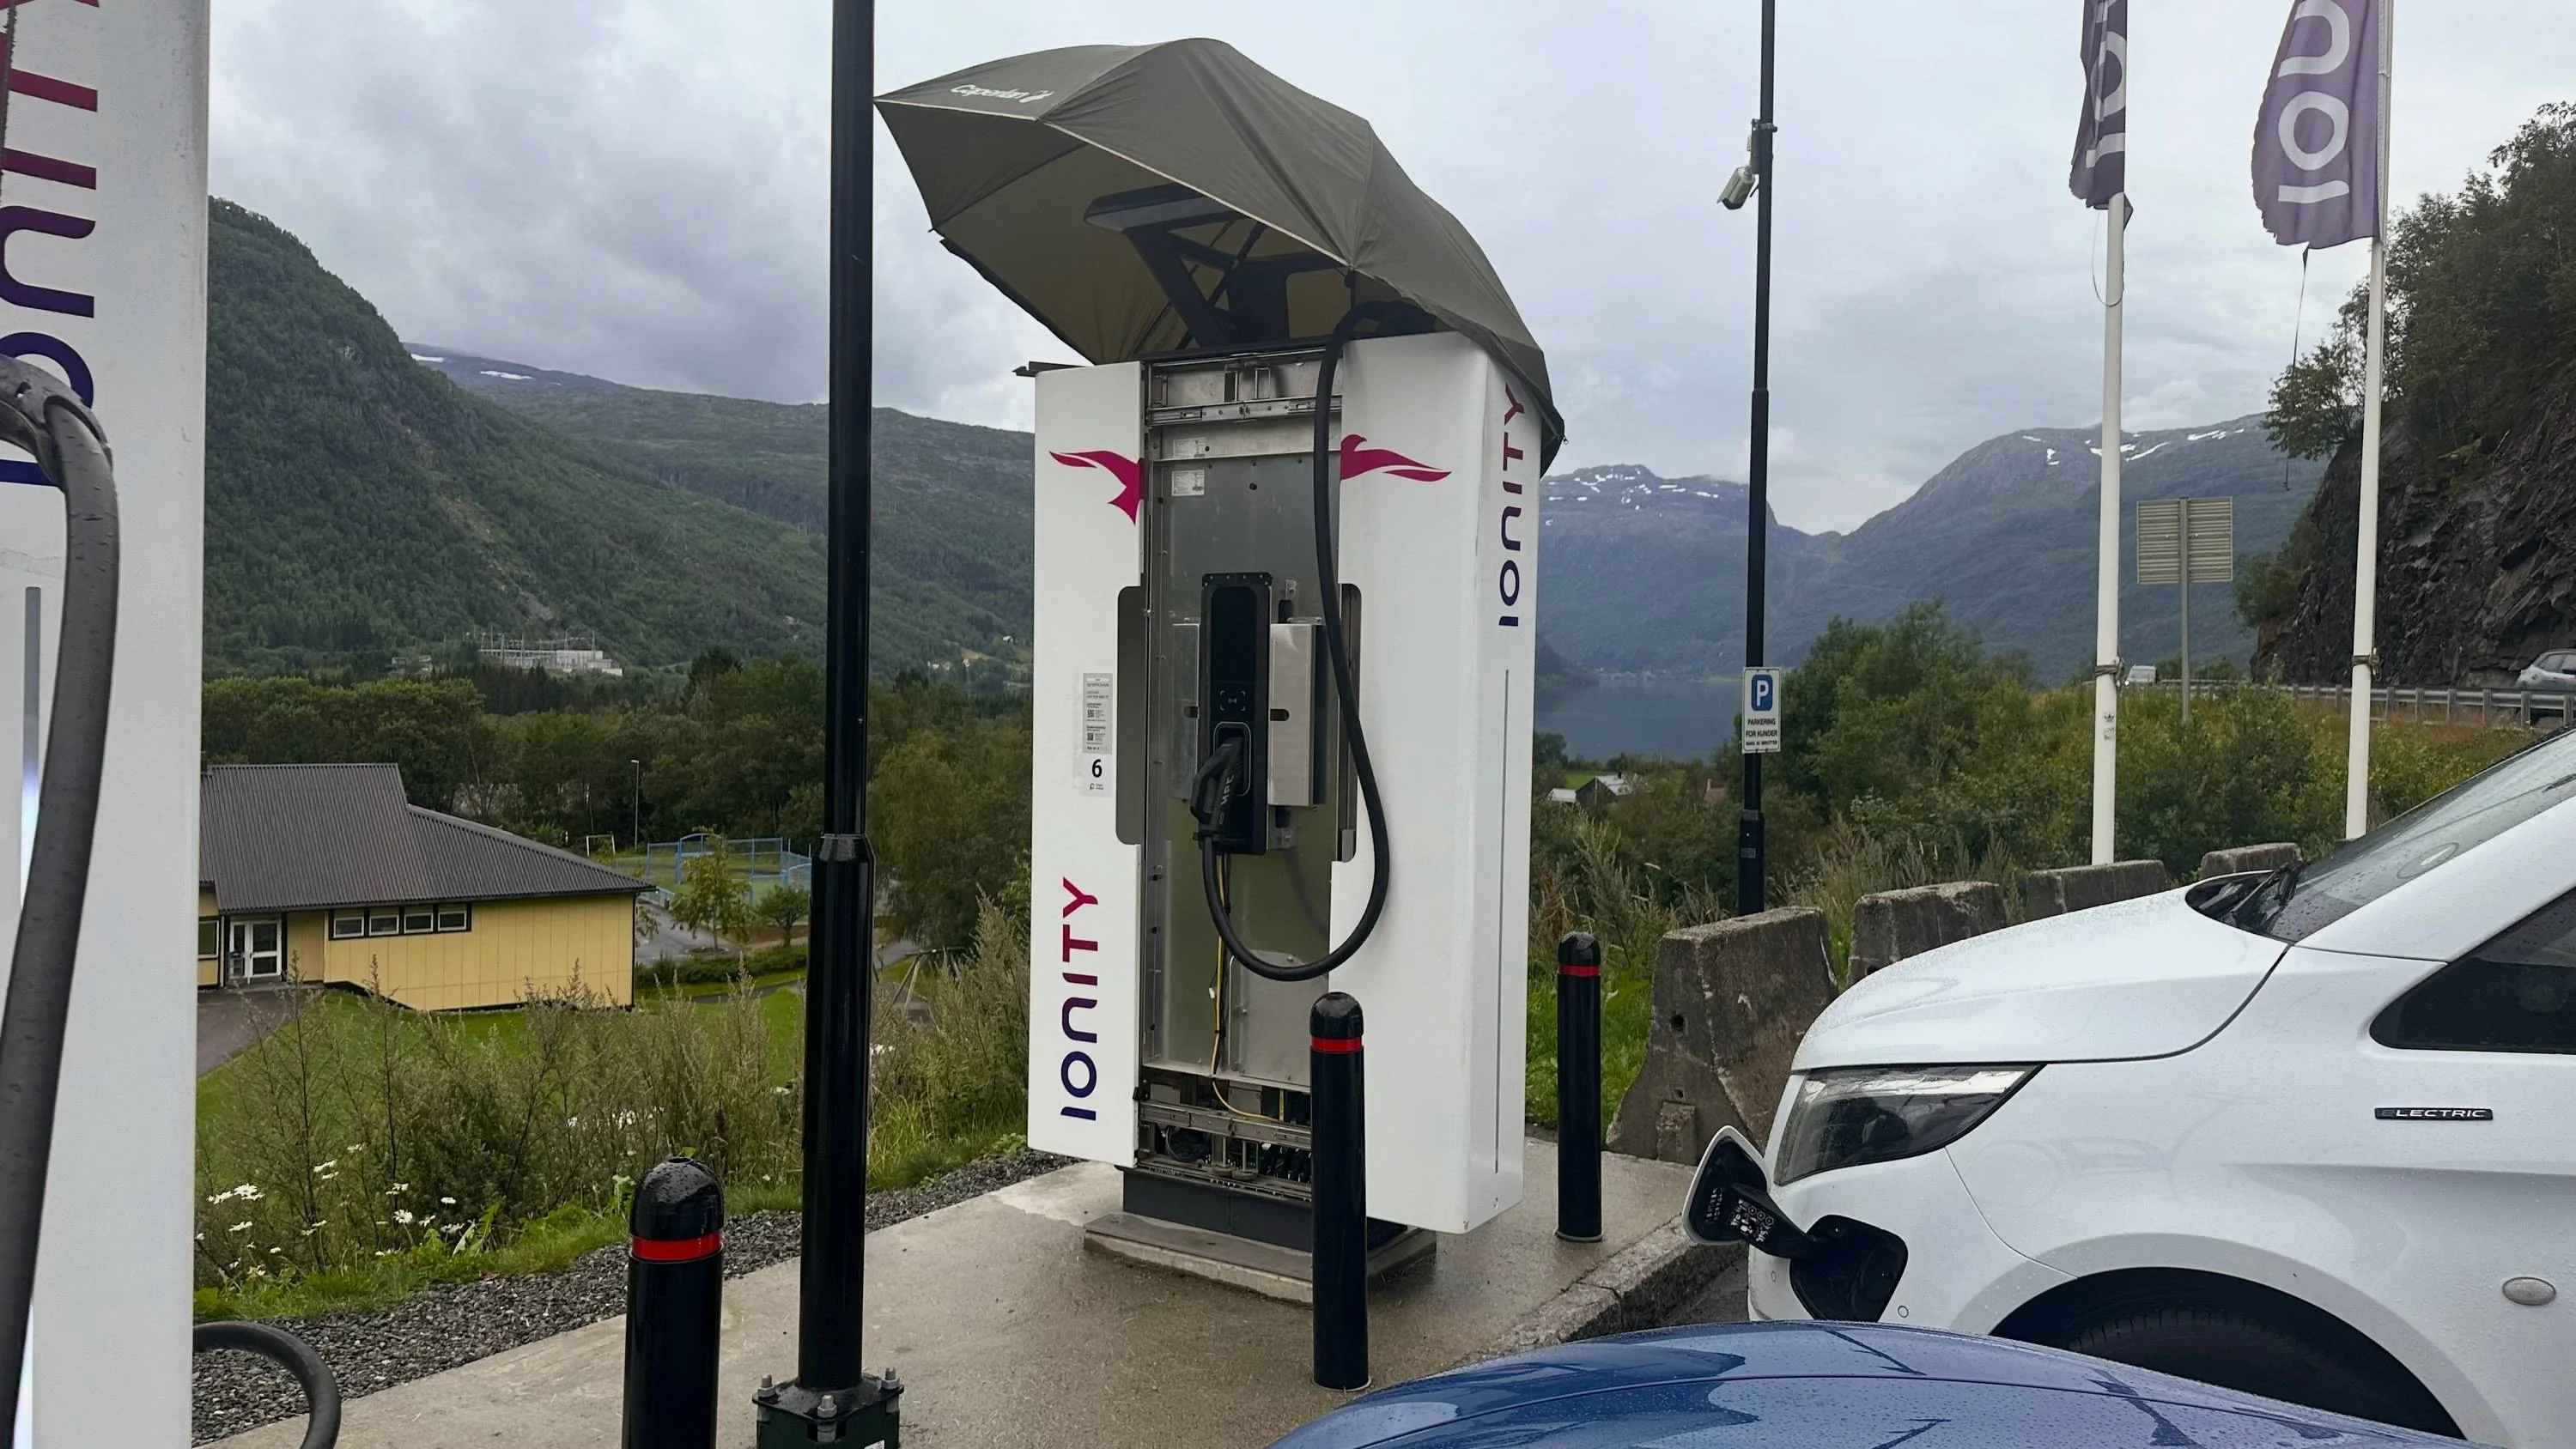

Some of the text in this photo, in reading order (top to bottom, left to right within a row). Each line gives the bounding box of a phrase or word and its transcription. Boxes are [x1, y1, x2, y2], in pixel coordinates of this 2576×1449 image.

[1498, 382, 1525, 627] IONITY
[1756, 680, 1770, 706] P
[1747, 718, 1776, 726] PARKERING
[1757, 729, 1777, 737] KUNDER
[1091, 759, 1103, 778] 6
[1060, 876, 1098, 1121] IONITY
